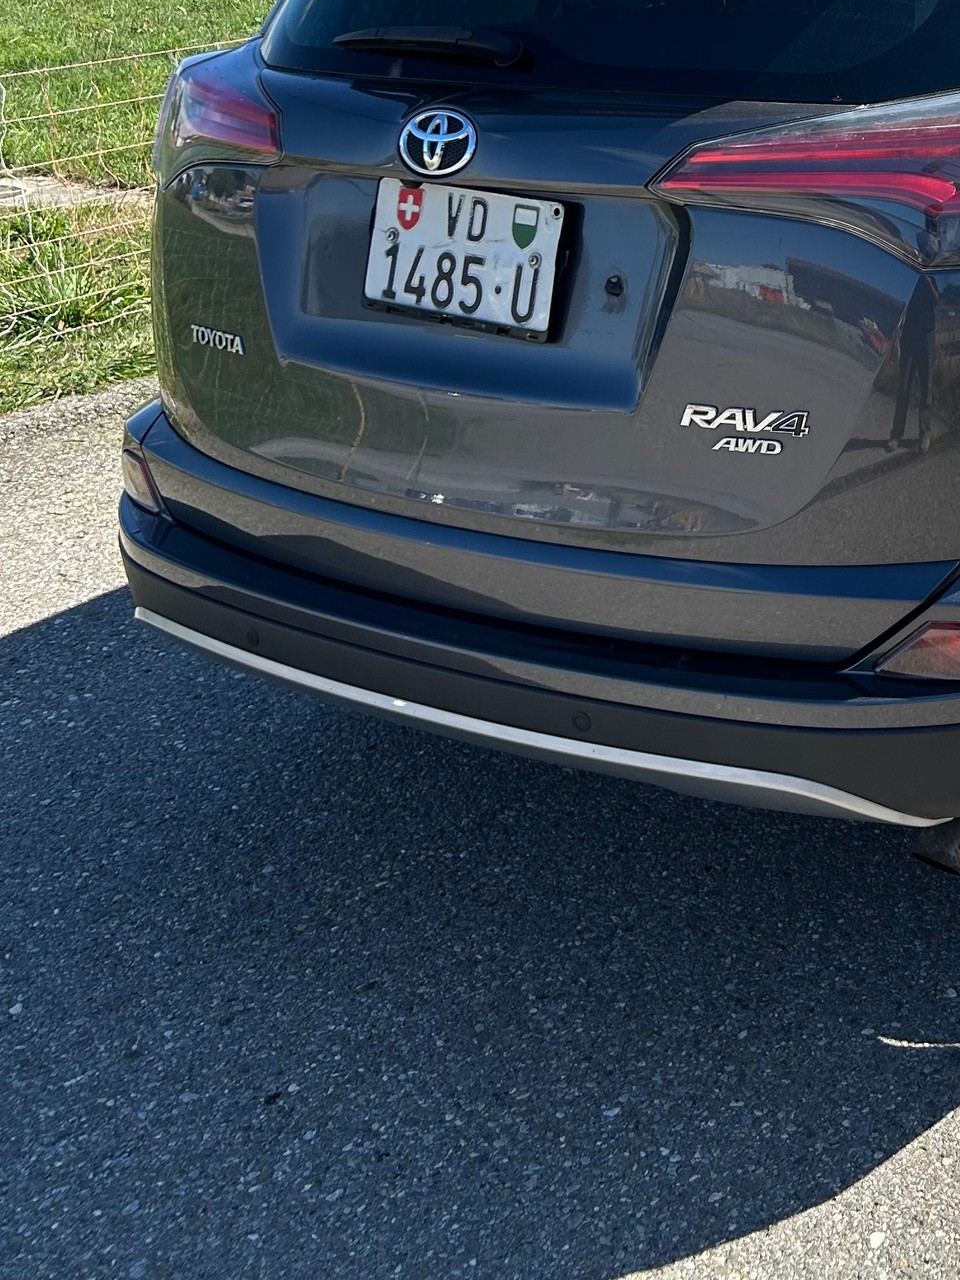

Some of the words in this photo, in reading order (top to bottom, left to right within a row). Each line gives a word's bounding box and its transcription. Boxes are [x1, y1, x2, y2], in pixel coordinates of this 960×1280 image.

[448, 193, 489, 242] VD
[191, 324, 245, 355] TOYOTA
[680, 403, 810, 438] RAV4
[711, 436, 783, 455] AWD
